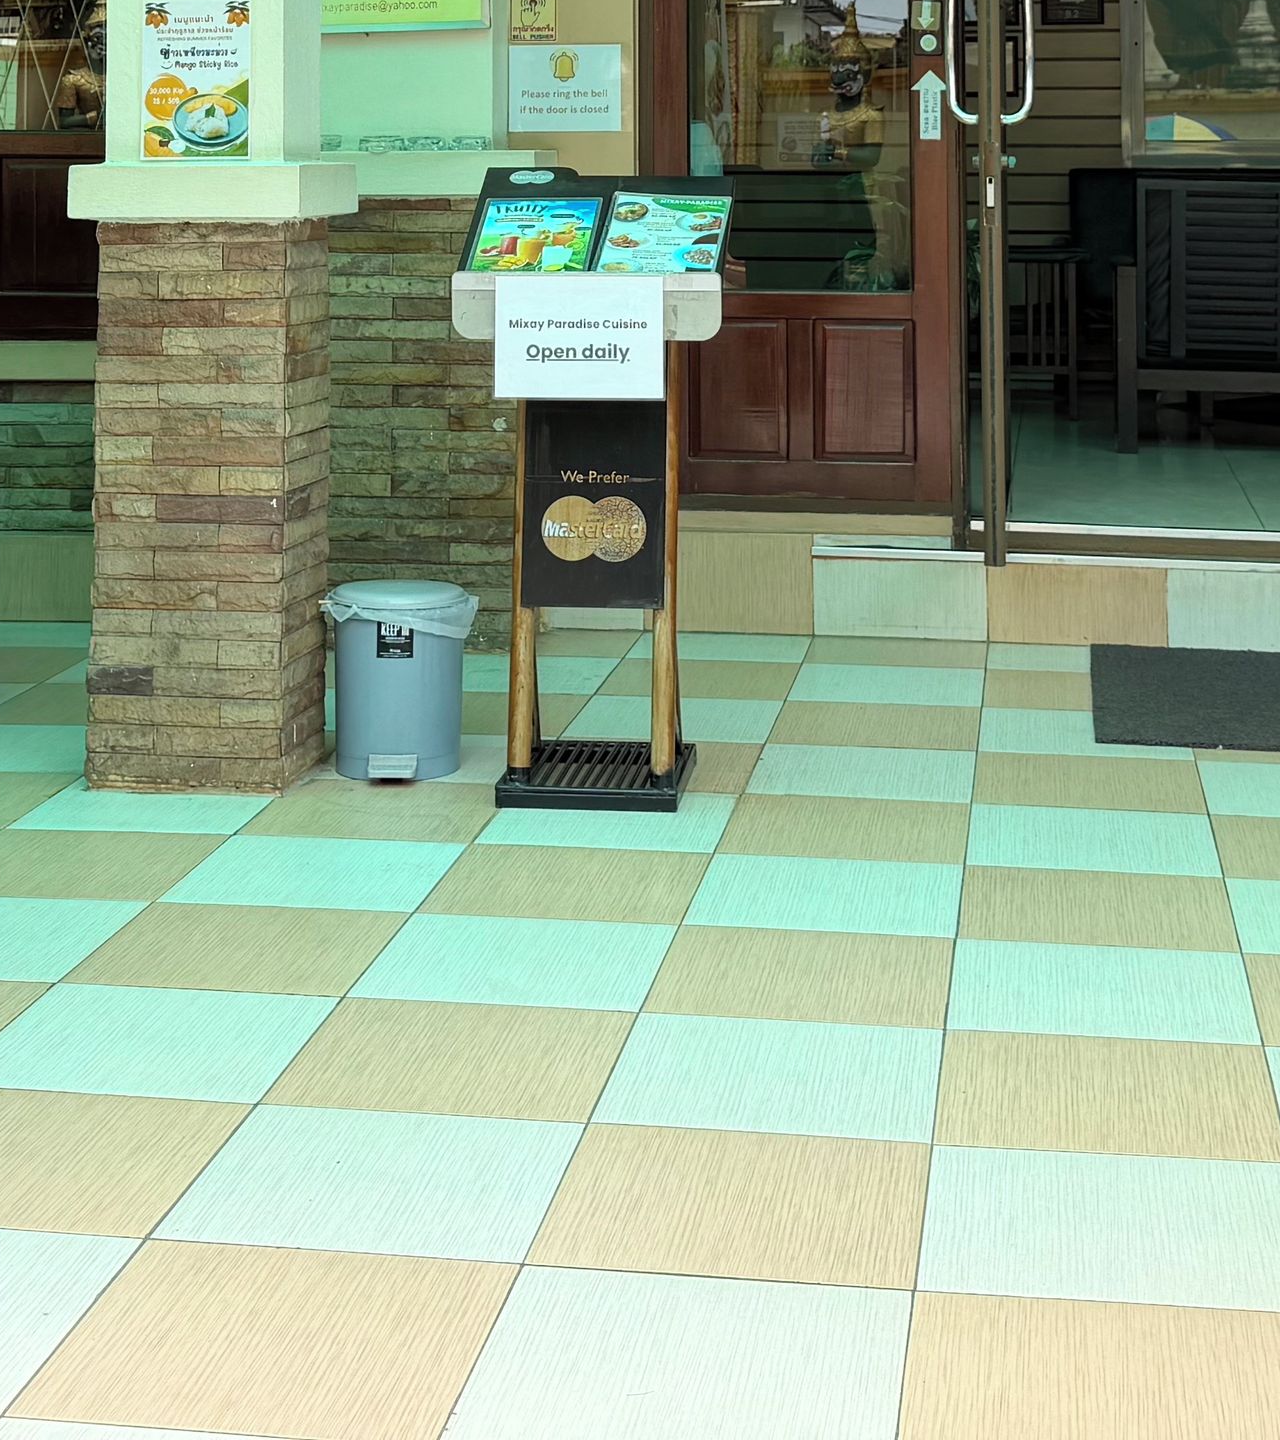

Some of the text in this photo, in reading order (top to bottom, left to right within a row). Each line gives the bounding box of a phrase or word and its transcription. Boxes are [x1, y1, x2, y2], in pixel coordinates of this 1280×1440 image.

[521, 89, 608, 100] Please ring the bell
[520, 104, 609, 114] if the door is closed
[508, 318, 648, 333] Mixay Paradise Cuisine
[525, 343, 578, 364] Open
[560, 470, 631, 485] We Prefer
[542, 517, 643, 540] MasterCard
